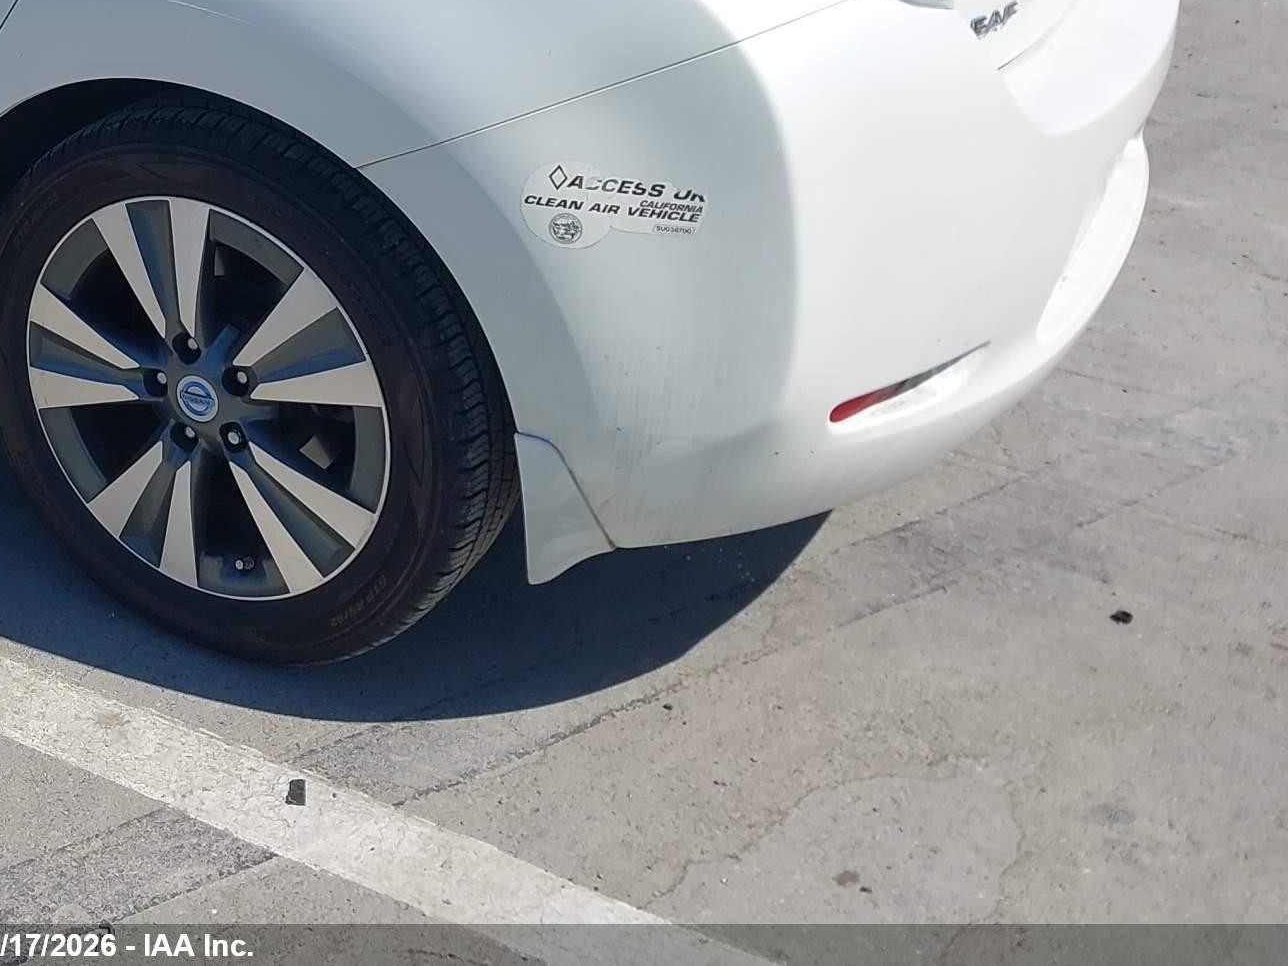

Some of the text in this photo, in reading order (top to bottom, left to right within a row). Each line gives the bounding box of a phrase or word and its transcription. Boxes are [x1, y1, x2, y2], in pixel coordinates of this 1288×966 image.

[523, 194, 702, 224] CLEAN AIR VEHICLE
[639, 200, 704, 214] CALIFORNIA
